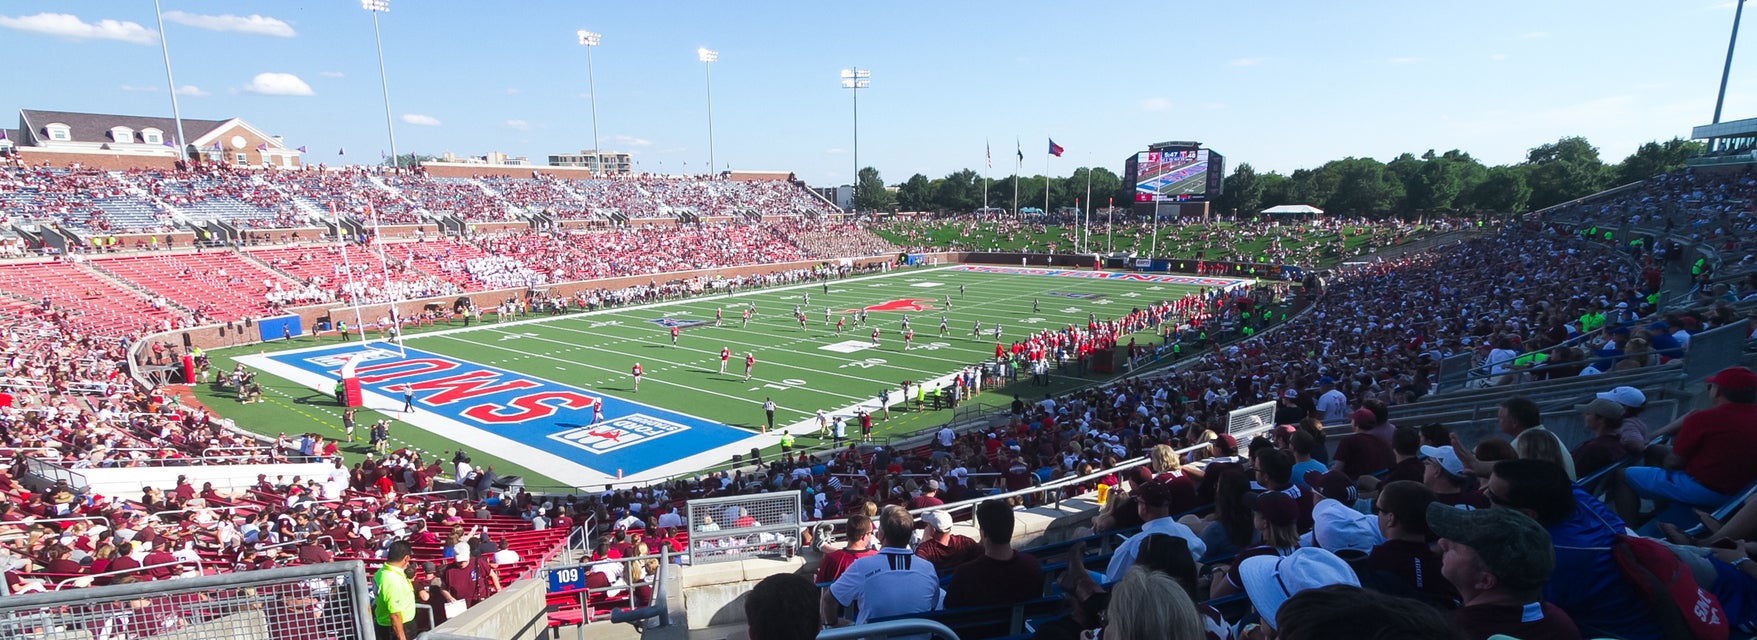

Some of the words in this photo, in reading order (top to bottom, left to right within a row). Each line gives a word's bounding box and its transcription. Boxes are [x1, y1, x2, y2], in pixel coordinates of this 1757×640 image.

[328, 358, 598, 424] SMU
[612, 420, 665, 436] FORD
[556, 568, 579, 583] 109
[1694, 588, 1712, 623] SMU
